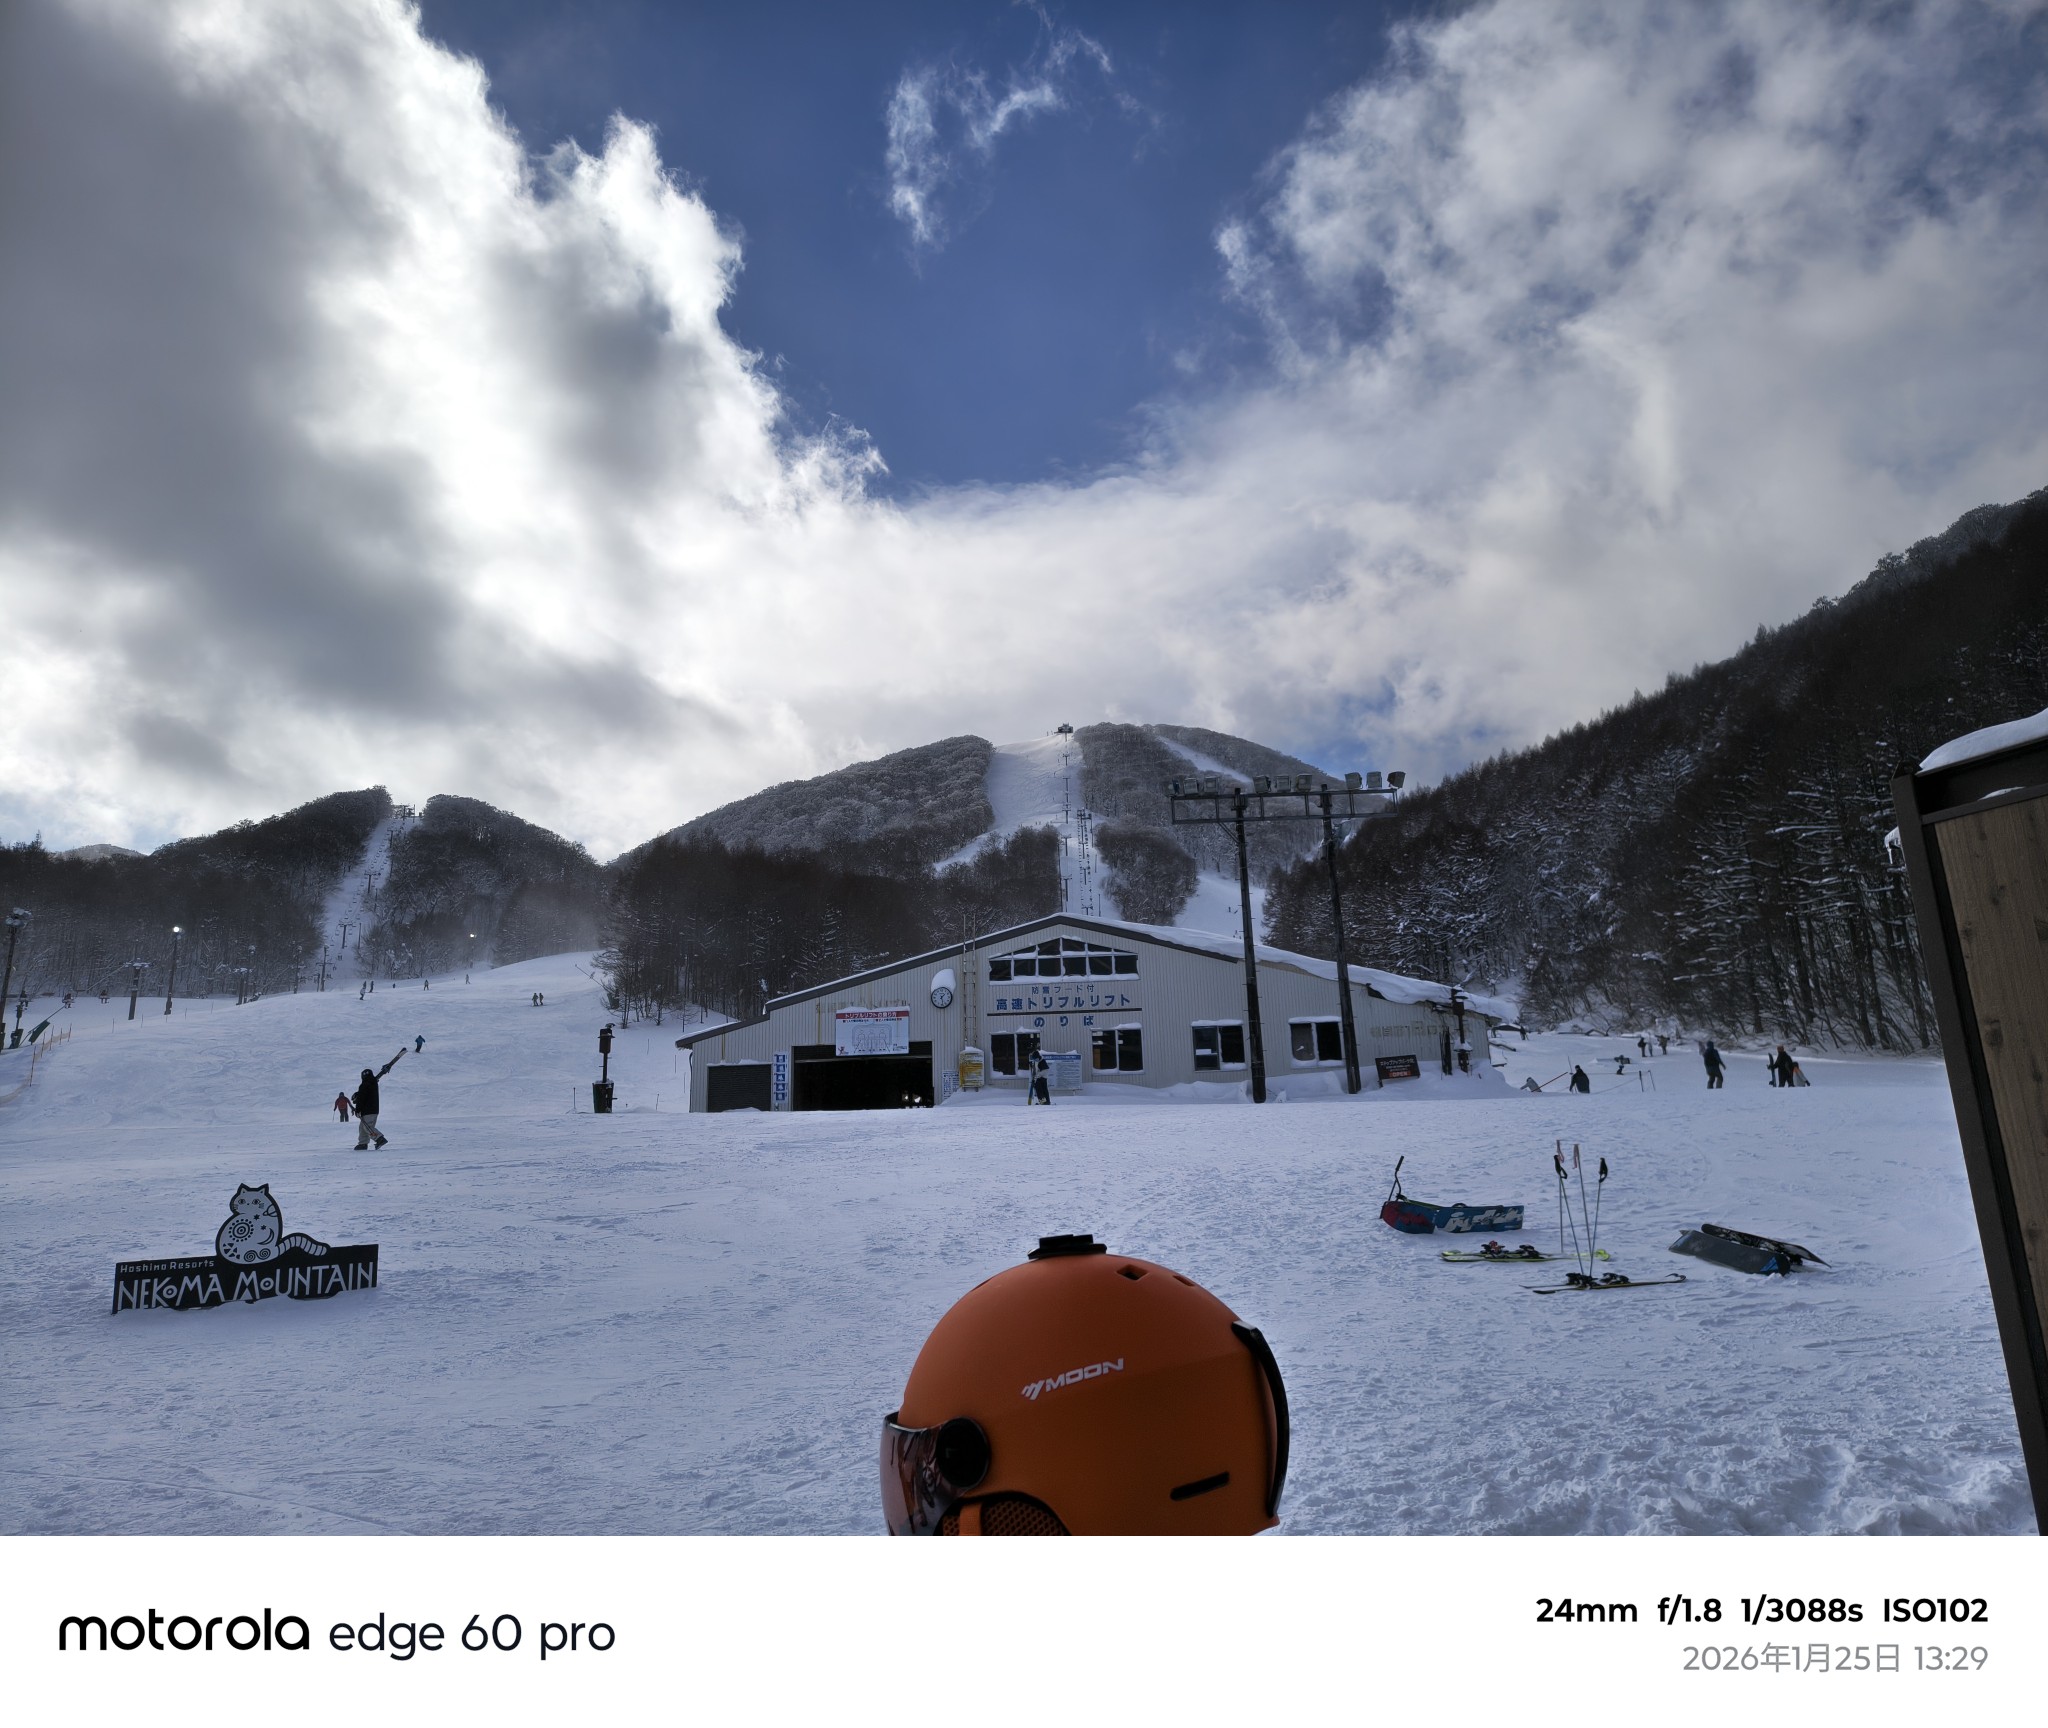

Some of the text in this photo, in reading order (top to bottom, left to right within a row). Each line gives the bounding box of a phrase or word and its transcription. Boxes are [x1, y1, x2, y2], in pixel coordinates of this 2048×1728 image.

[996, 993, 1131, 1010] 高速トリプルリフト
[1034, 1015, 1095, 1027] のりば
[120, 1258, 215, 1273] Hoshino Resorts
[1045, 1357, 1124, 1393] MOON
